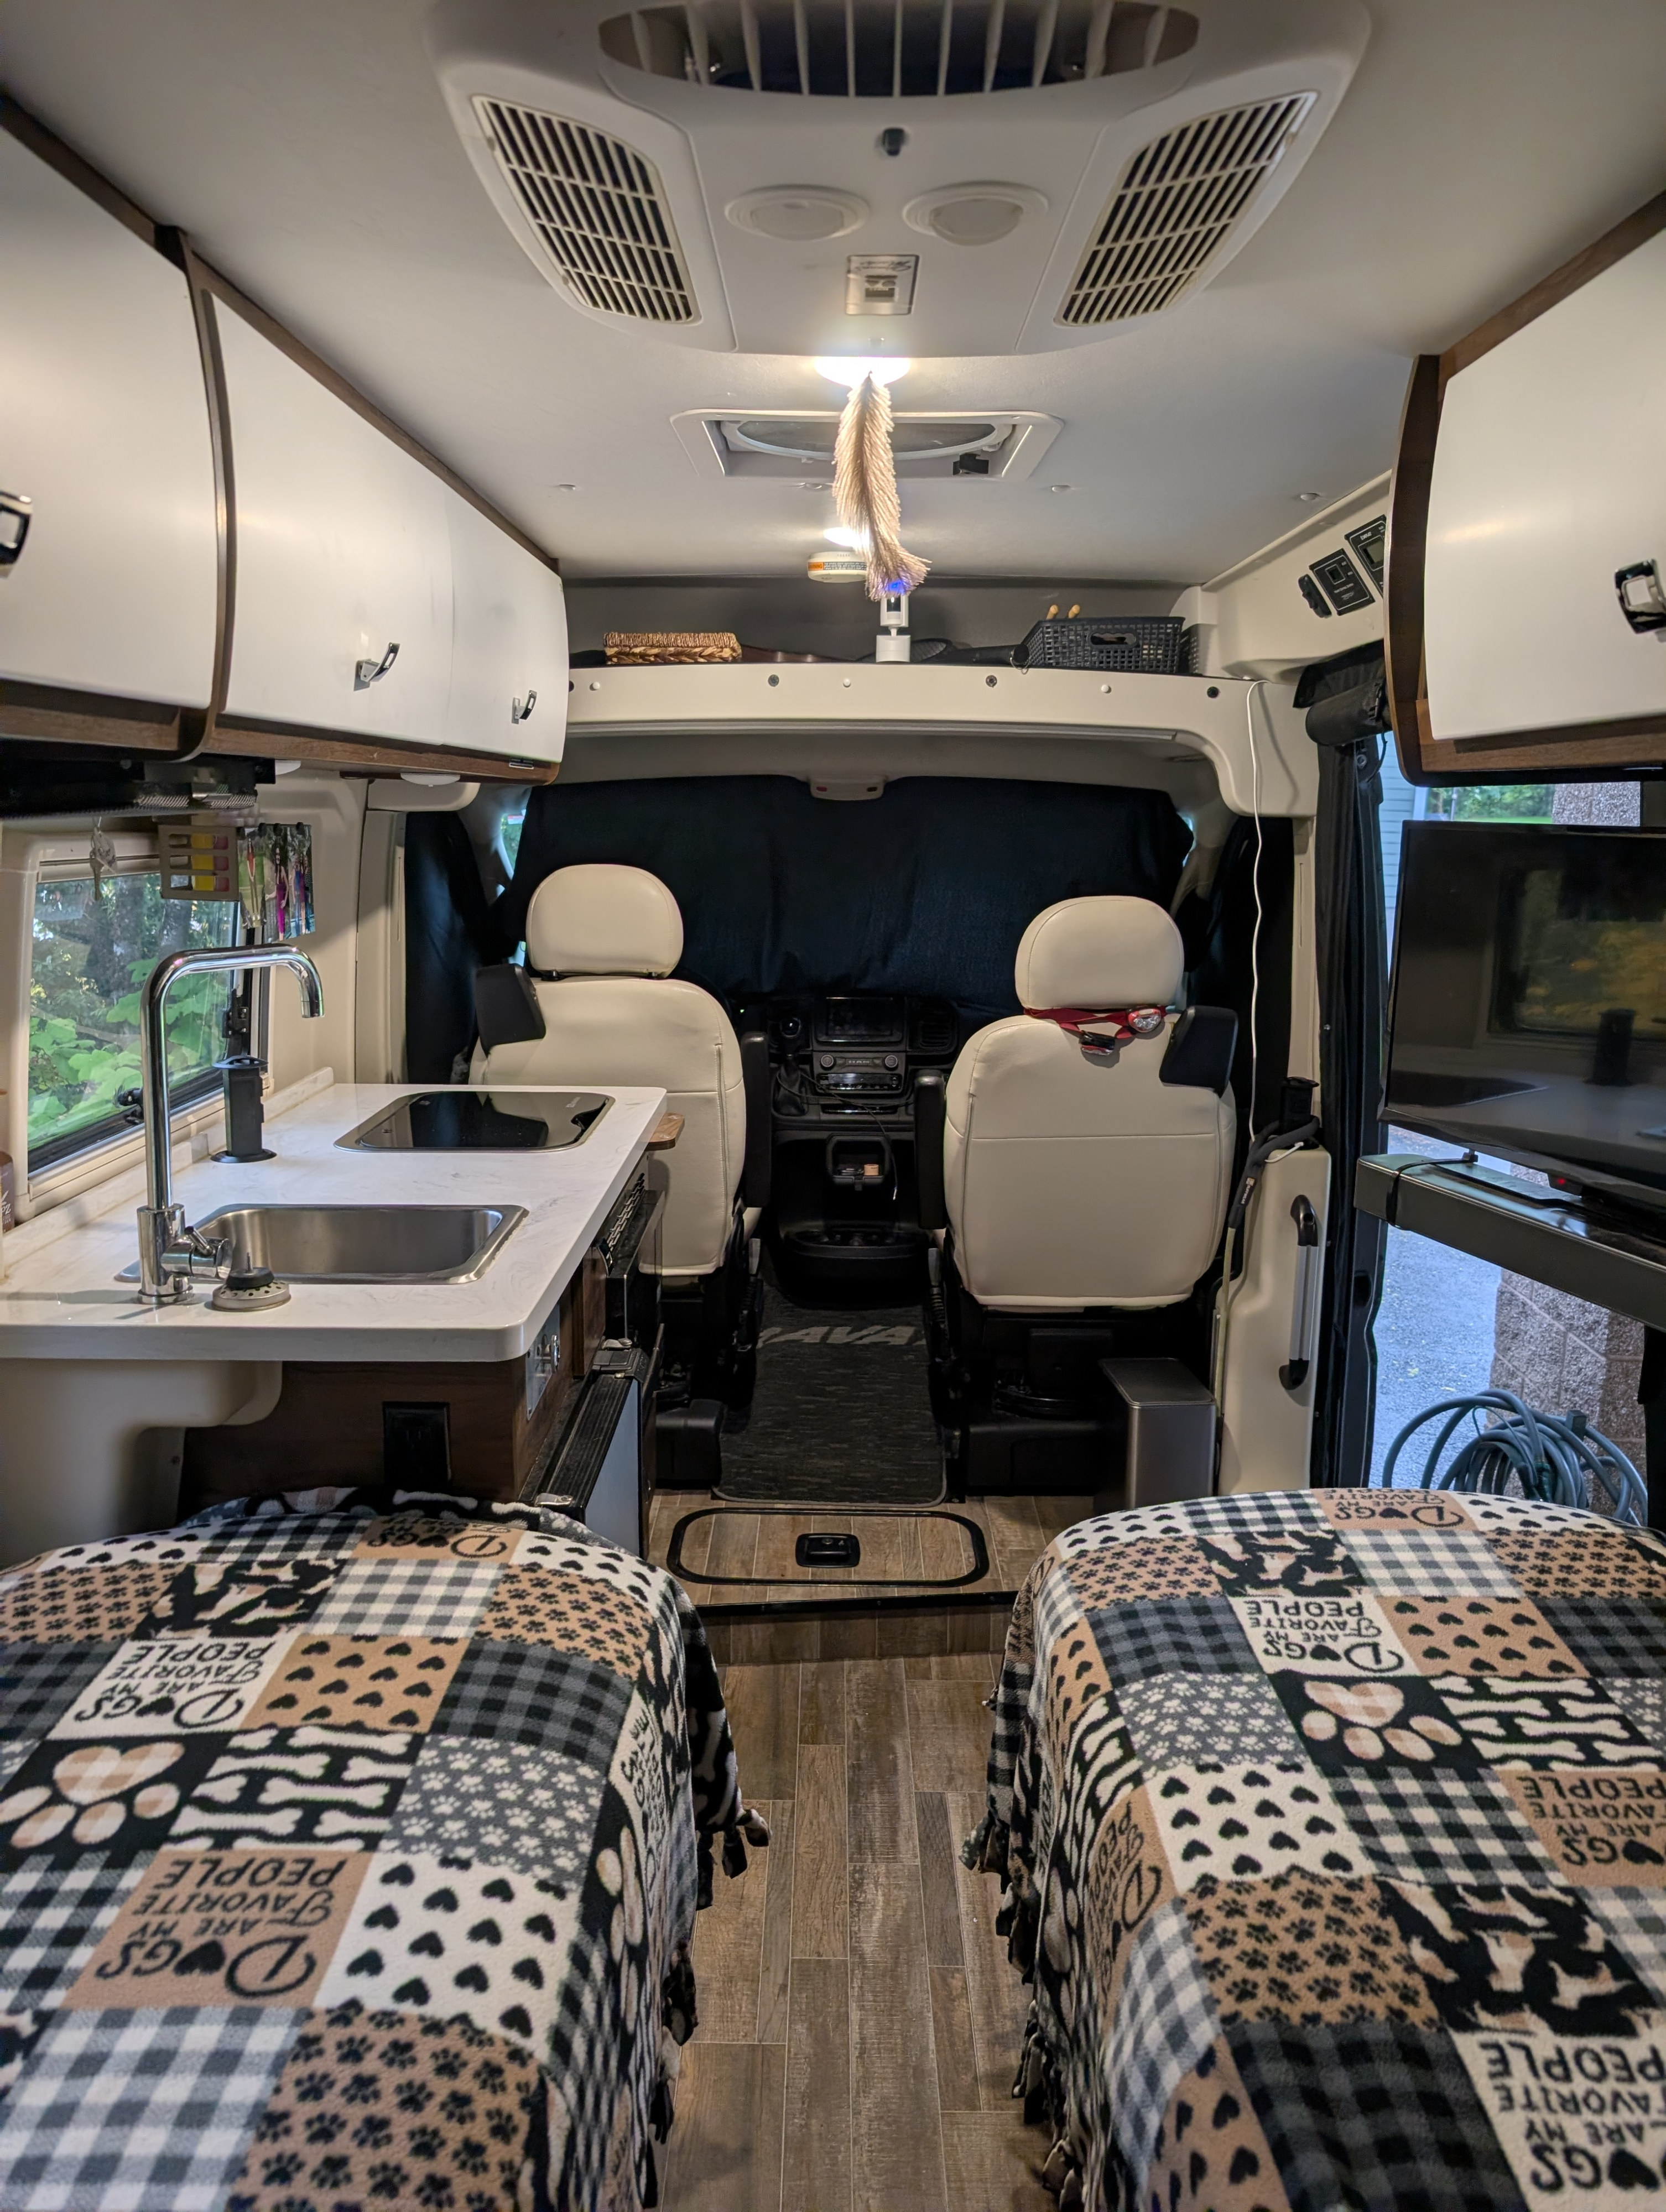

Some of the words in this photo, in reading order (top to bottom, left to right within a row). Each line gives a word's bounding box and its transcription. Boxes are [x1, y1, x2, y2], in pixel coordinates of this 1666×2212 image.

[756, 1325, 927, 1349] AVA
[1244, 1600, 1364, 1617] PEOPLE
[1249, 1617, 1382, 1637] FAVORITE
[1263, 1631, 1289, 1641] MY
[1302, 1632, 1339, 1642] ARE
[122, 1641, 276, 1665] PEOPLE
[106, 1660, 264, 1684] FAVORITE
[101, 1682, 141, 1697] MY
[149, 1681, 205, 1694] ARE
[1516, 1776, 1666, 1800] PEOPLE
[1529, 1802, 1666, 1828] AVORITE
[1556, 1823, 1589, 1837] MY
[1601, 1822, 1651, 1837] ARE
[154, 1858, 347, 1889] PEOPLE
[132, 1890, 335, 1927] FAVORITE
[128, 1921, 179, 1939] MY
[194, 1917, 262, 1936] ARE
[1479, 2041, 1666, 2083] PEOPLE
[1493, 2084, 1666, 2128] AVORITE
[1525, 2117, 1566, 2143] MY
[1584, 2121, 1644, 2146] ARE
